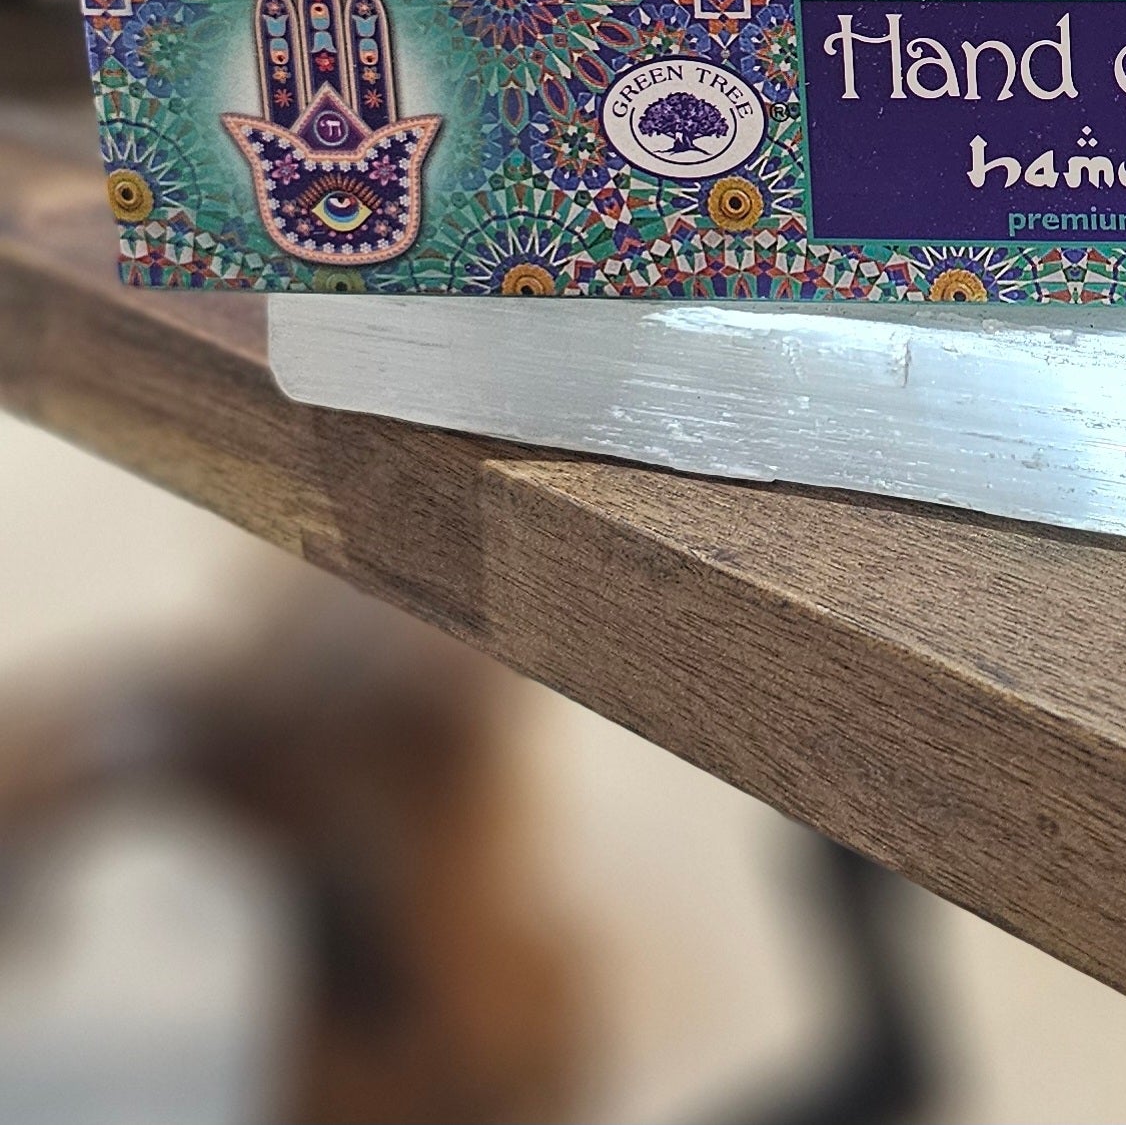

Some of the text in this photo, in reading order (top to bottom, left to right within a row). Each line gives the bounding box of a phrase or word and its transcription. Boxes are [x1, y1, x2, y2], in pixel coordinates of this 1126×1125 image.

[612, 64, 684, 118] GREEN
[695, 66, 754, 119] TREE
[824, 12, 1079, 101] Hand
